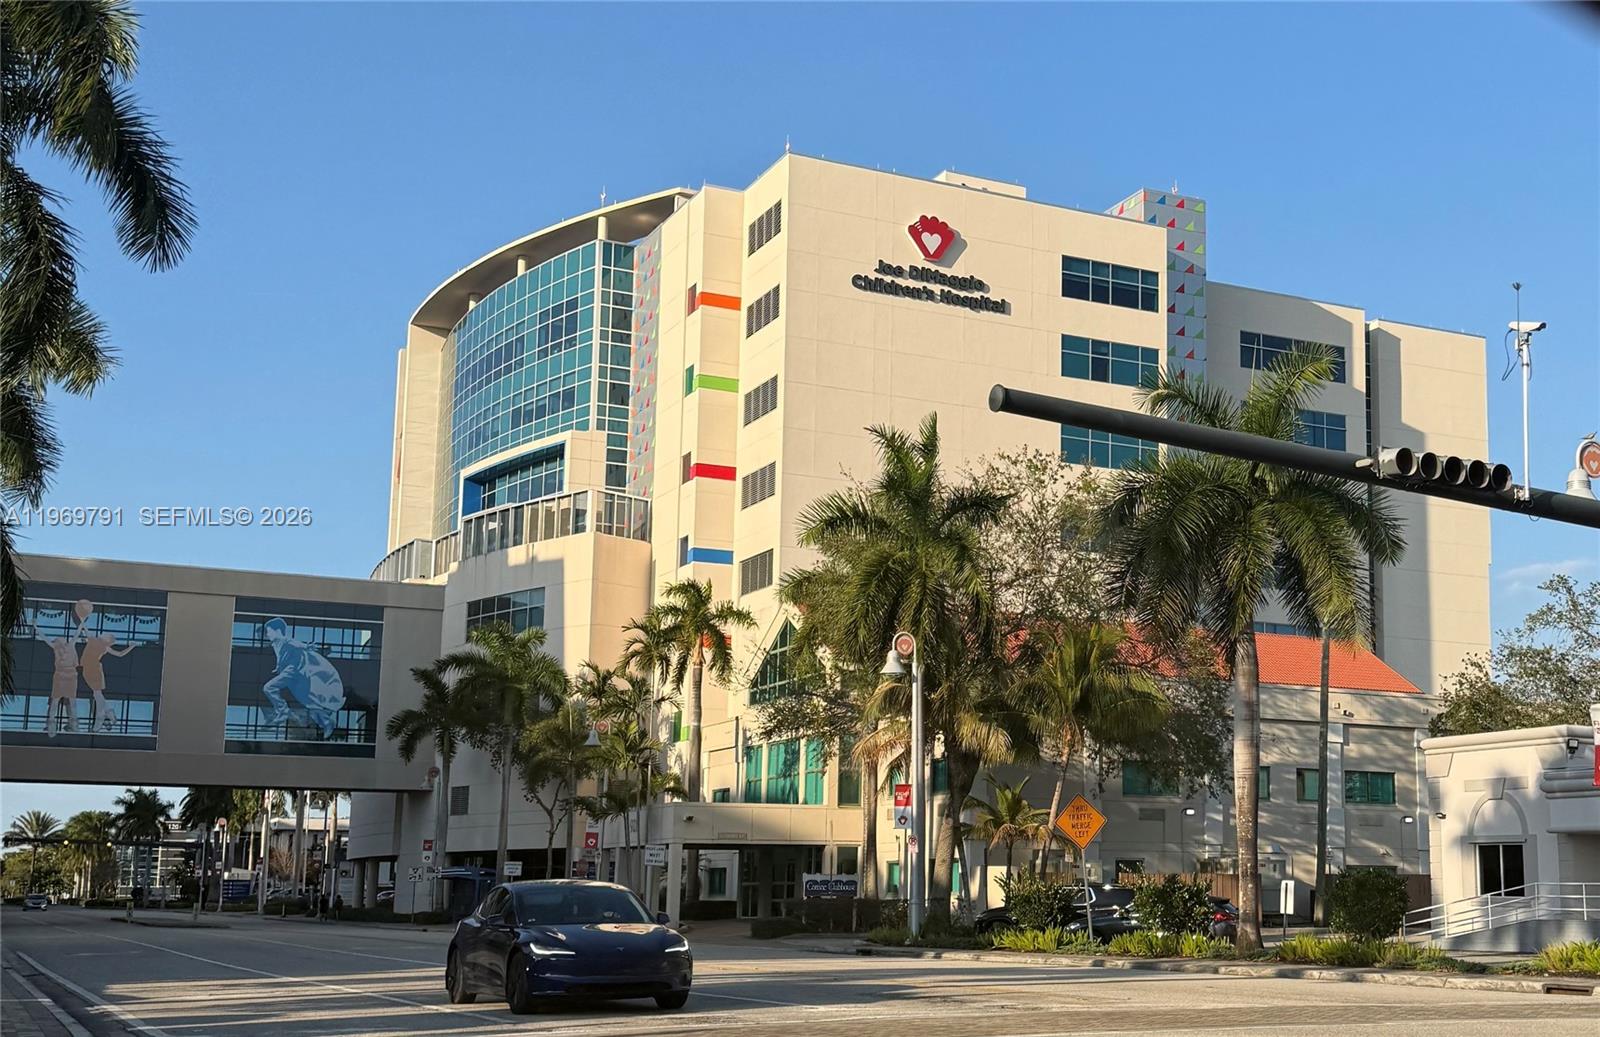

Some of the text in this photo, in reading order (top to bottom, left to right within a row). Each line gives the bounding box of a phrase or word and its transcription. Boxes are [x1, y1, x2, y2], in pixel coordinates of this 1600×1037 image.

[874, 259, 987, 292] Joe DiMaggio
[851, 274, 1008, 314] Children's Hospital
